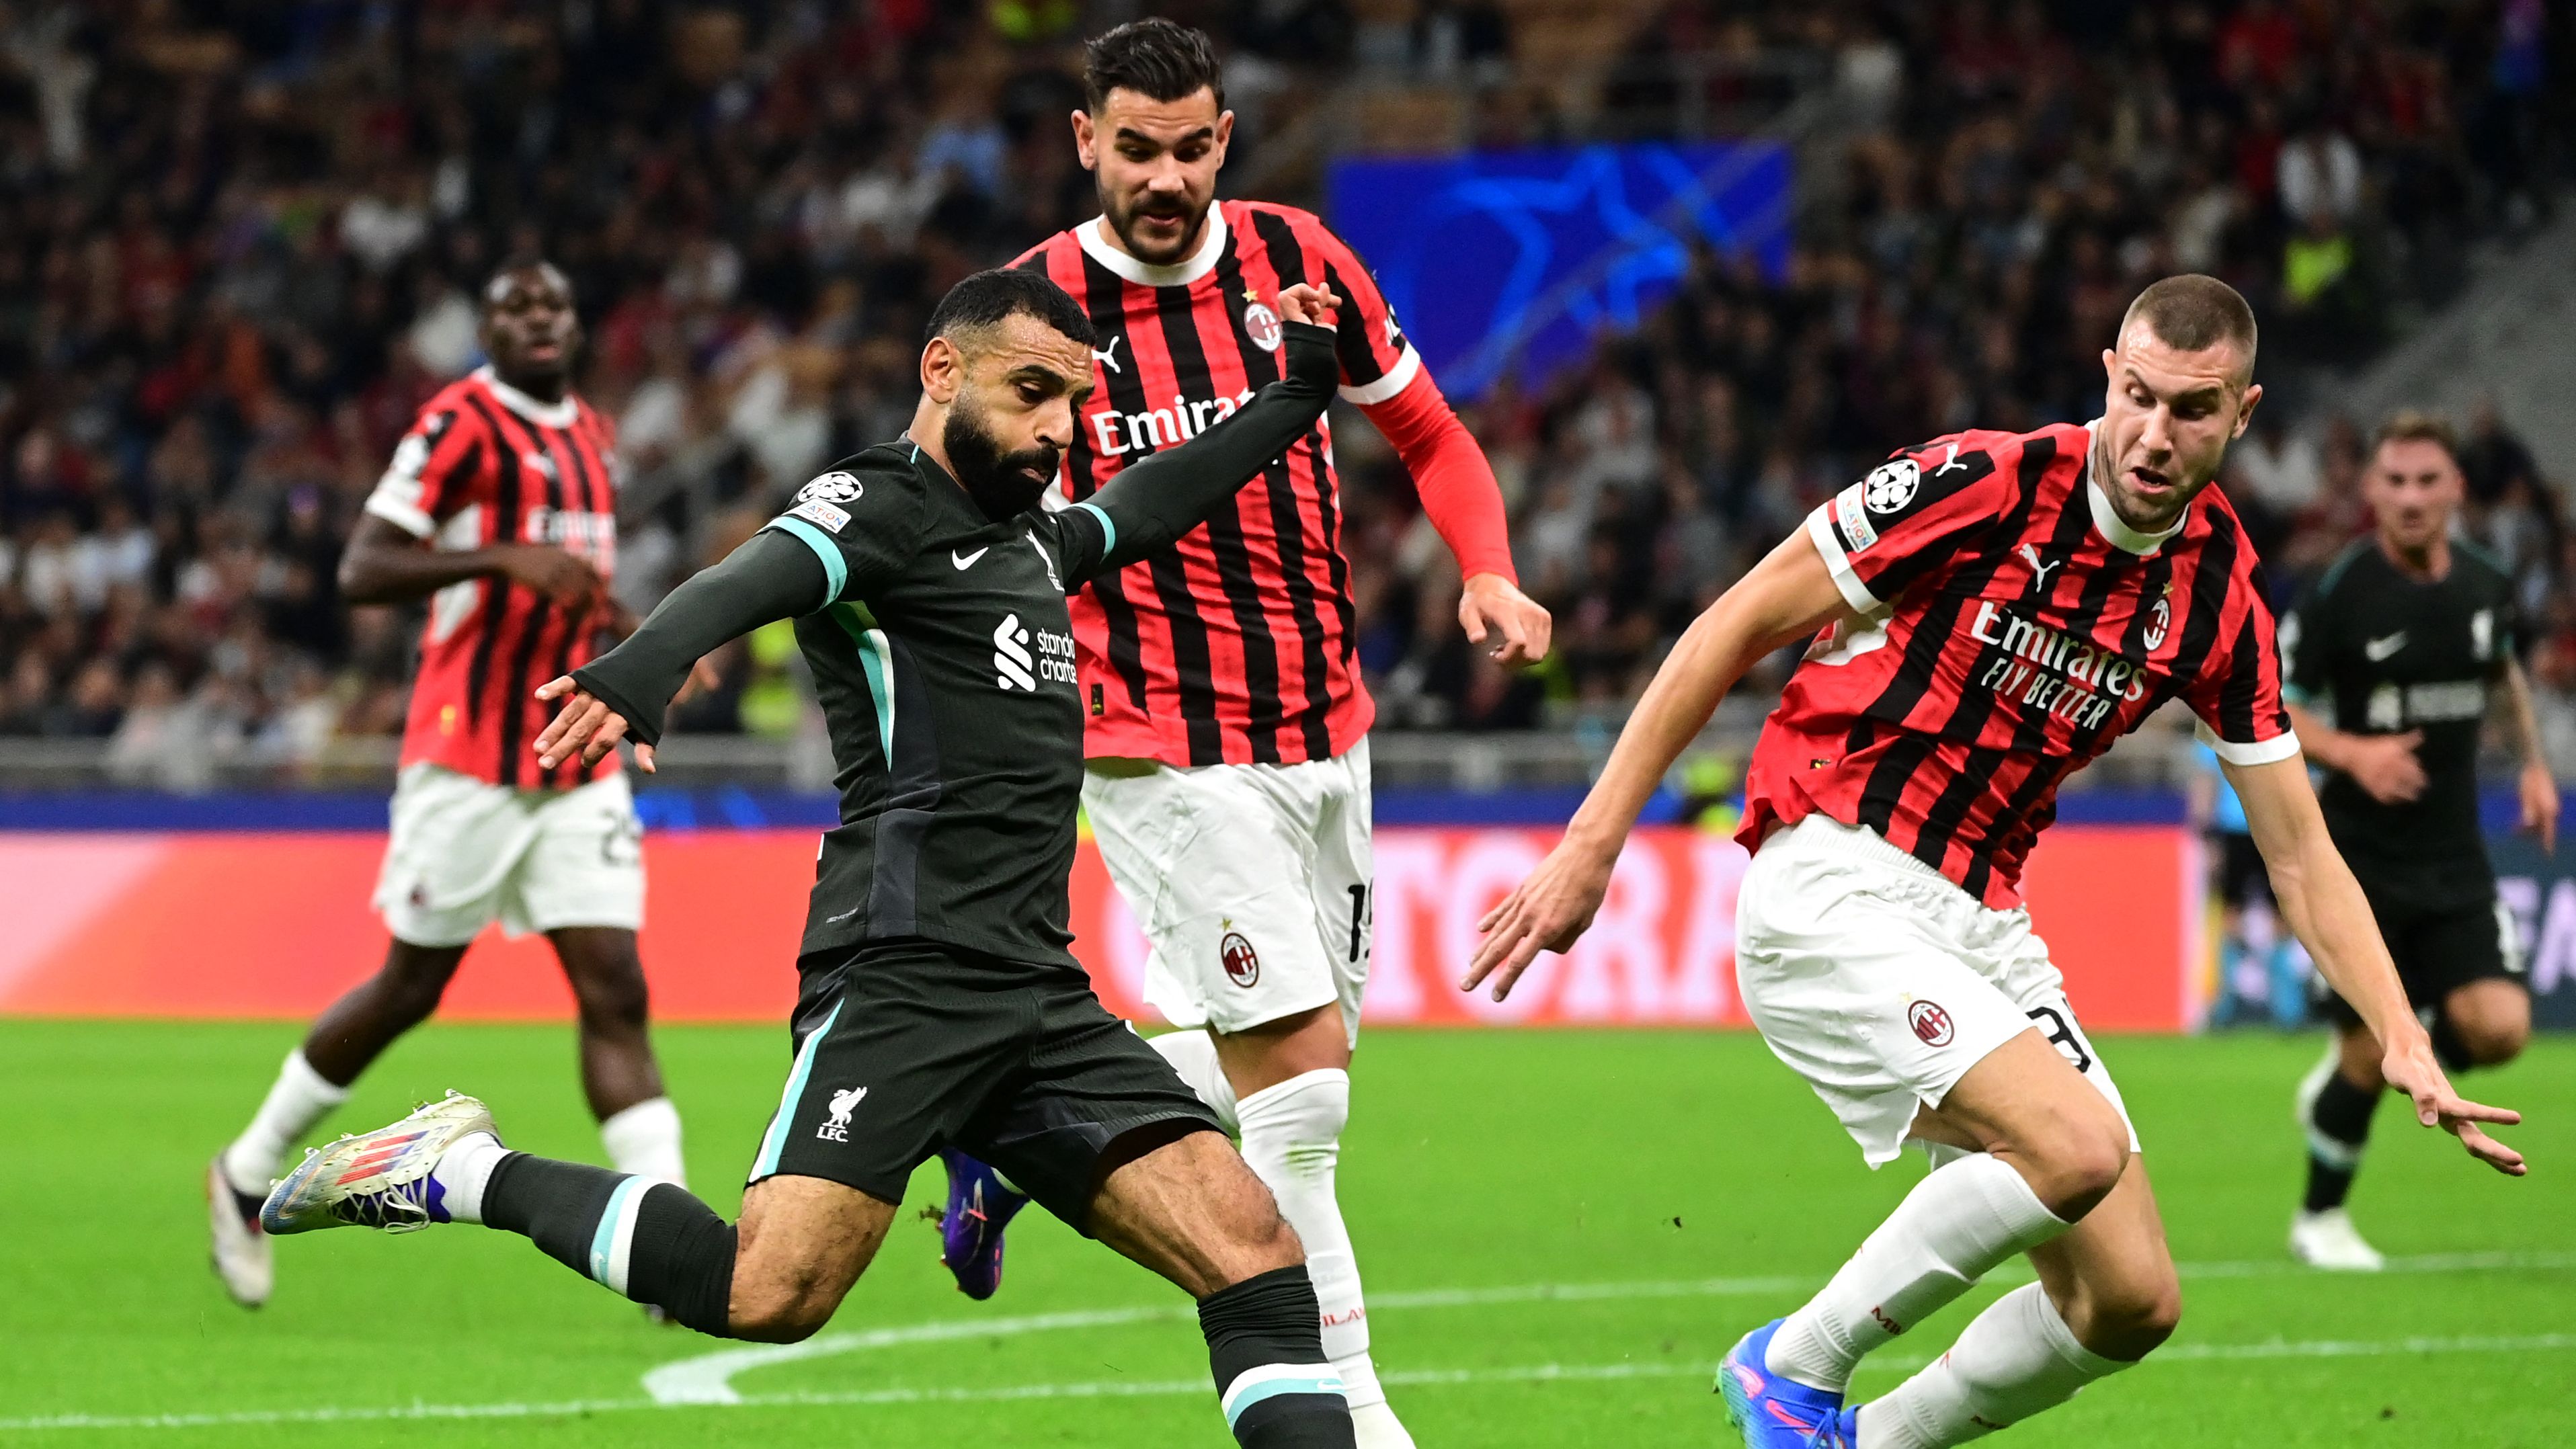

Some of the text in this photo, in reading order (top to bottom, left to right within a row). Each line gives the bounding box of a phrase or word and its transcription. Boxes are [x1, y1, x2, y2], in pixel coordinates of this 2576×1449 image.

[1971, 600, 2148, 702] Emirates
[1981, 657, 2112, 731] FLY BETTER
[1347, 877, 1373, 962] 1
[2025, 997, 2091, 1073] 3
